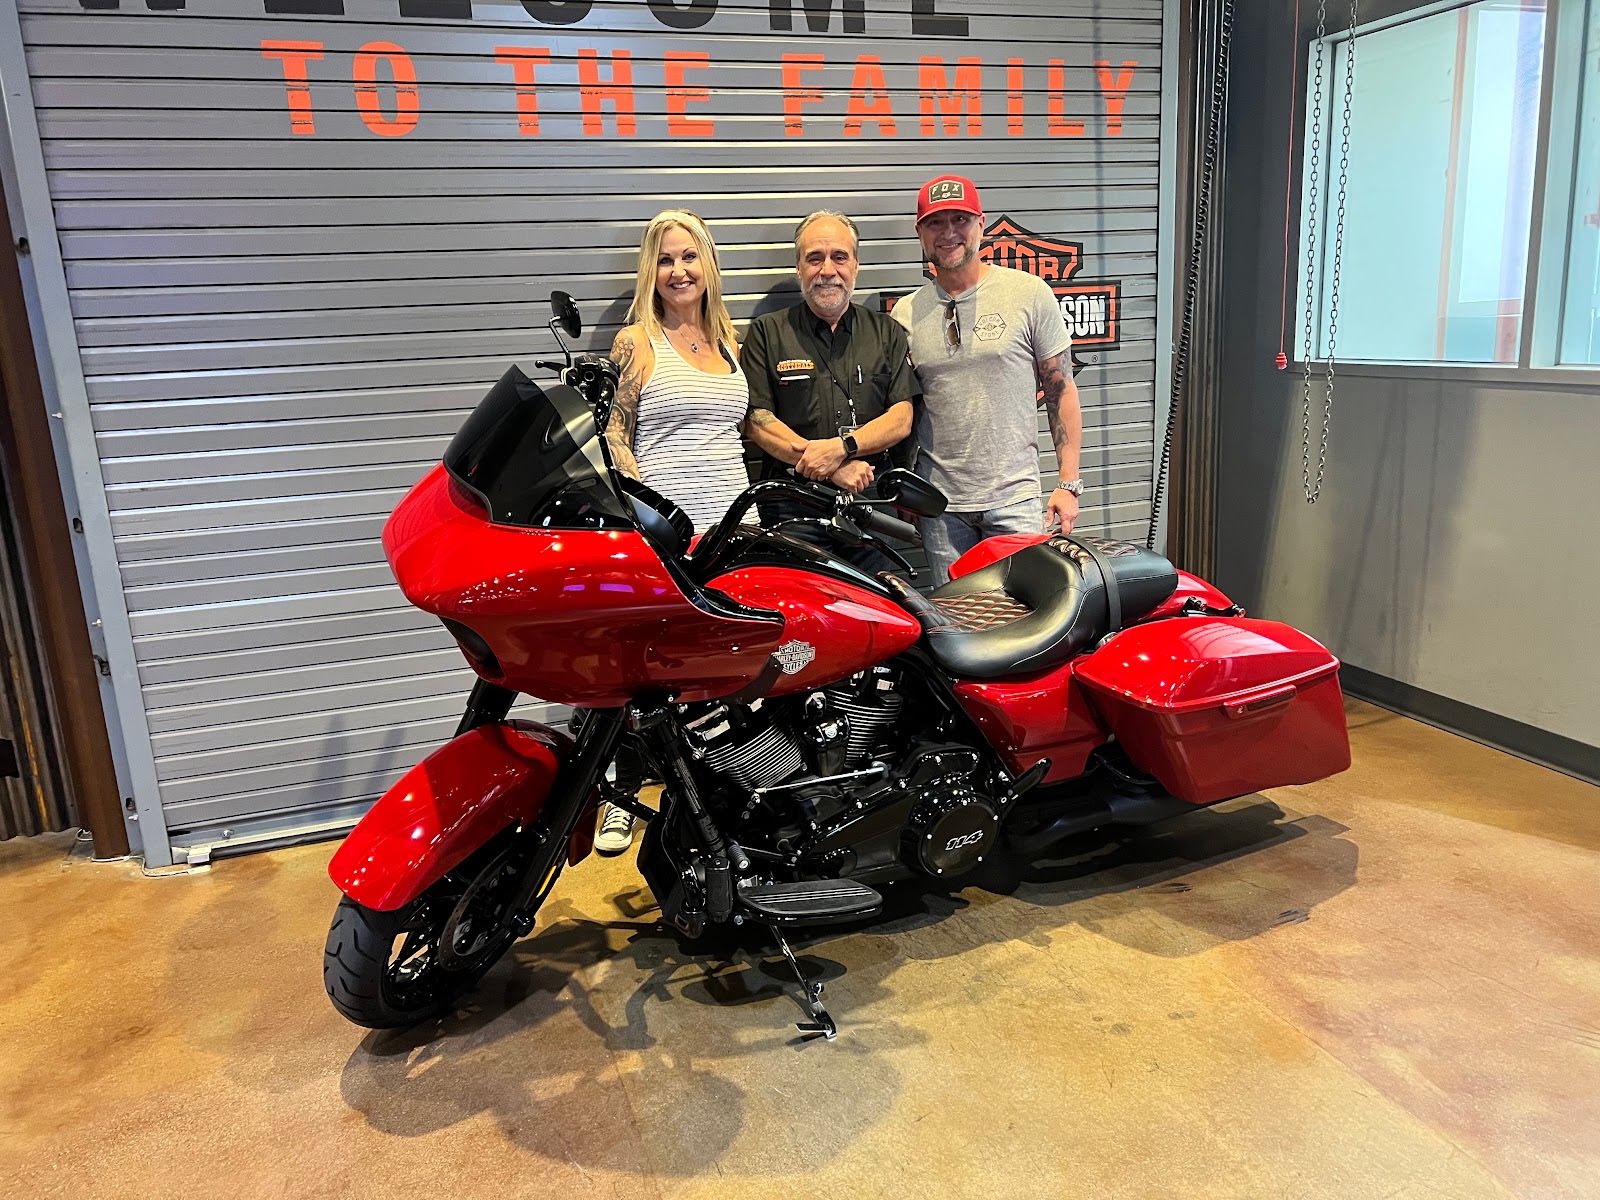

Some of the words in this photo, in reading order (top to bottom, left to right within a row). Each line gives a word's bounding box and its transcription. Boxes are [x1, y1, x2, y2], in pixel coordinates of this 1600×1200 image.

[261, 39, 420, 137] TO
[495, 46, 714, 137] THE
[782, 53, 1137, 137] FAMILY
[931, 183, 960, 195] FOX
[784, 644, 805, 653] MOTOR
[945, 829, 984, 851] 114
